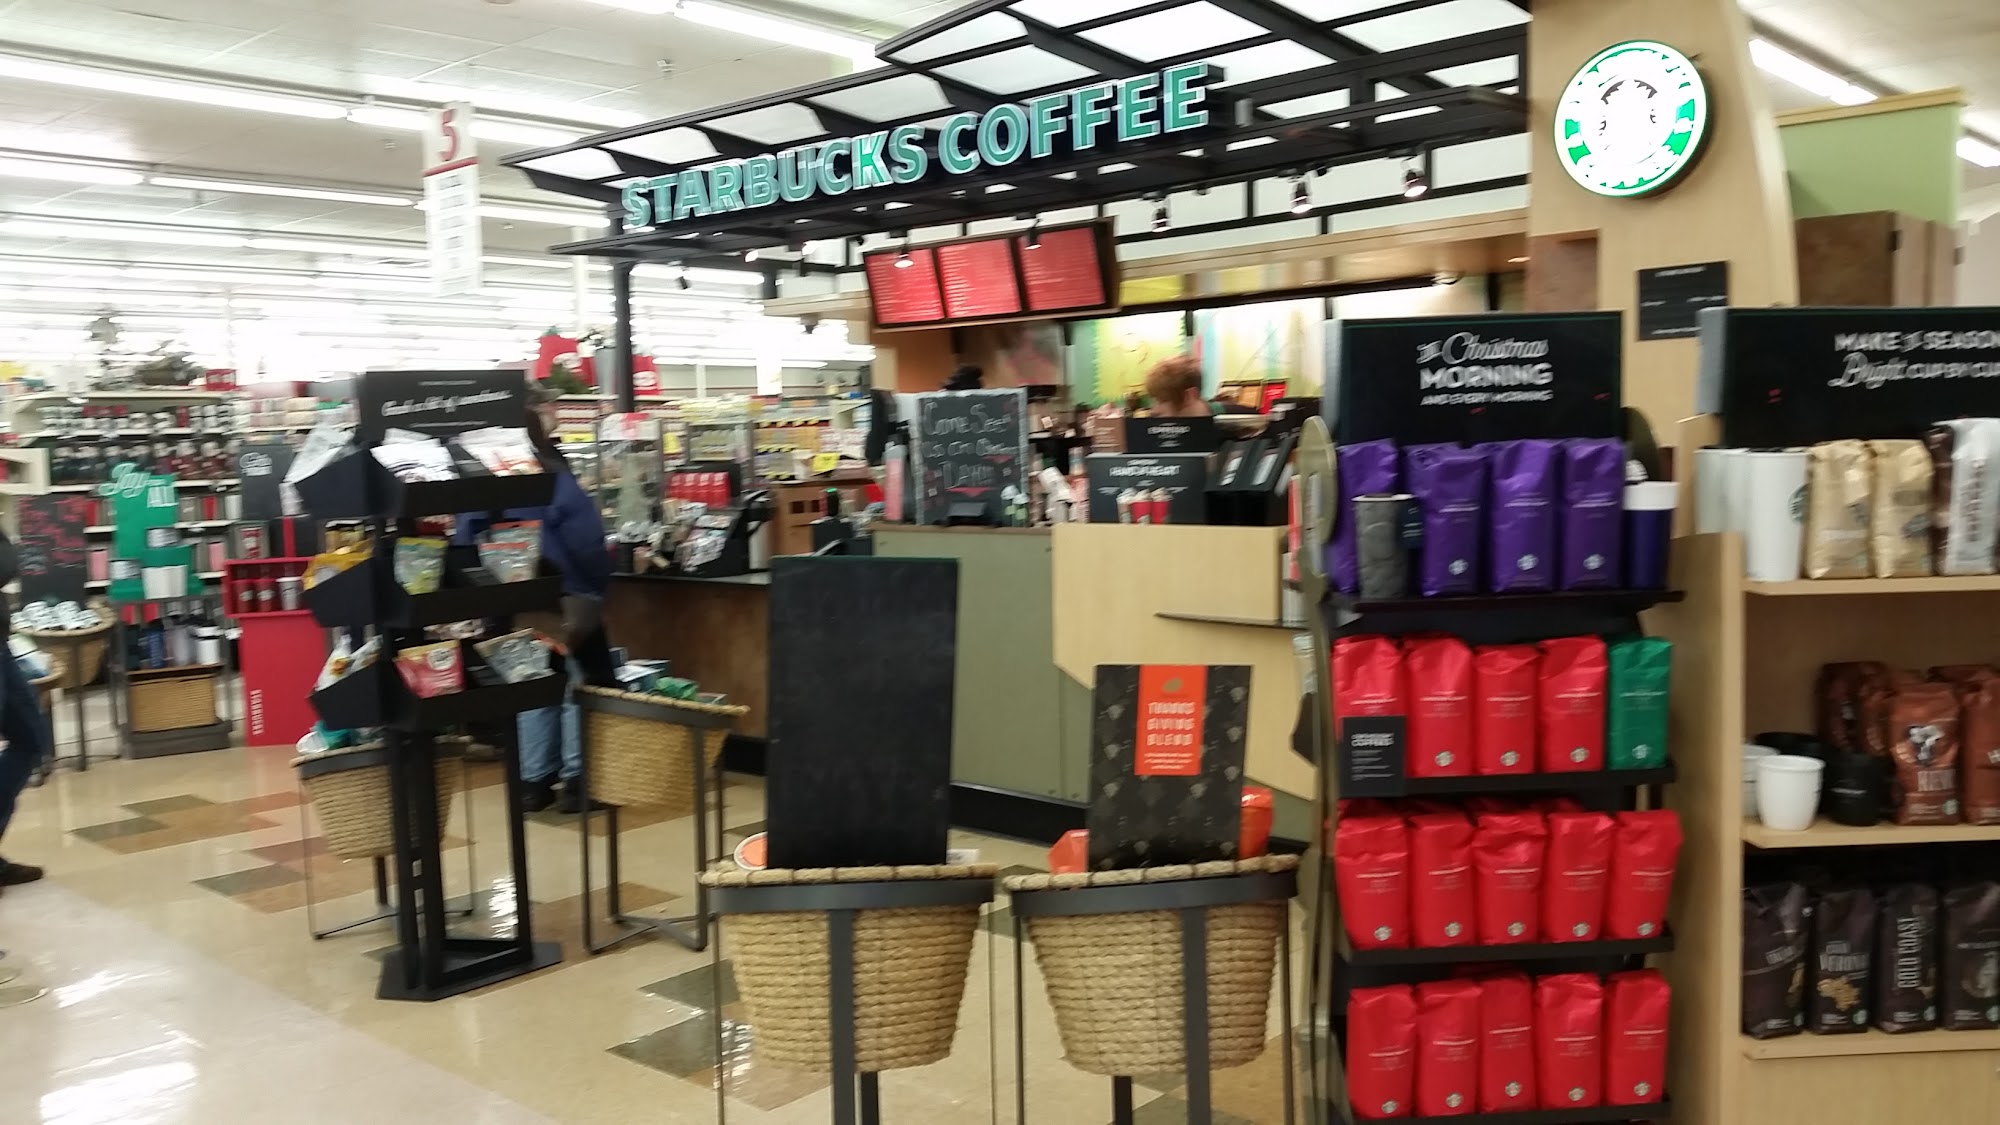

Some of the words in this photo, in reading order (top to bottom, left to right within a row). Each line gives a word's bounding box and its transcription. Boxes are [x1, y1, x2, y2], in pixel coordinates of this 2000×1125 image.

[438, 108, 460, 162] 5
[620, 124, 929, 230] STARBUCKS
[938, 61, 1210, 174] COFFEE
[1442, 331, 1550, 364] Christmas
[1834, 331, 1902, 351] MAKE
[1420, 363, 1553, 389] MORNING
